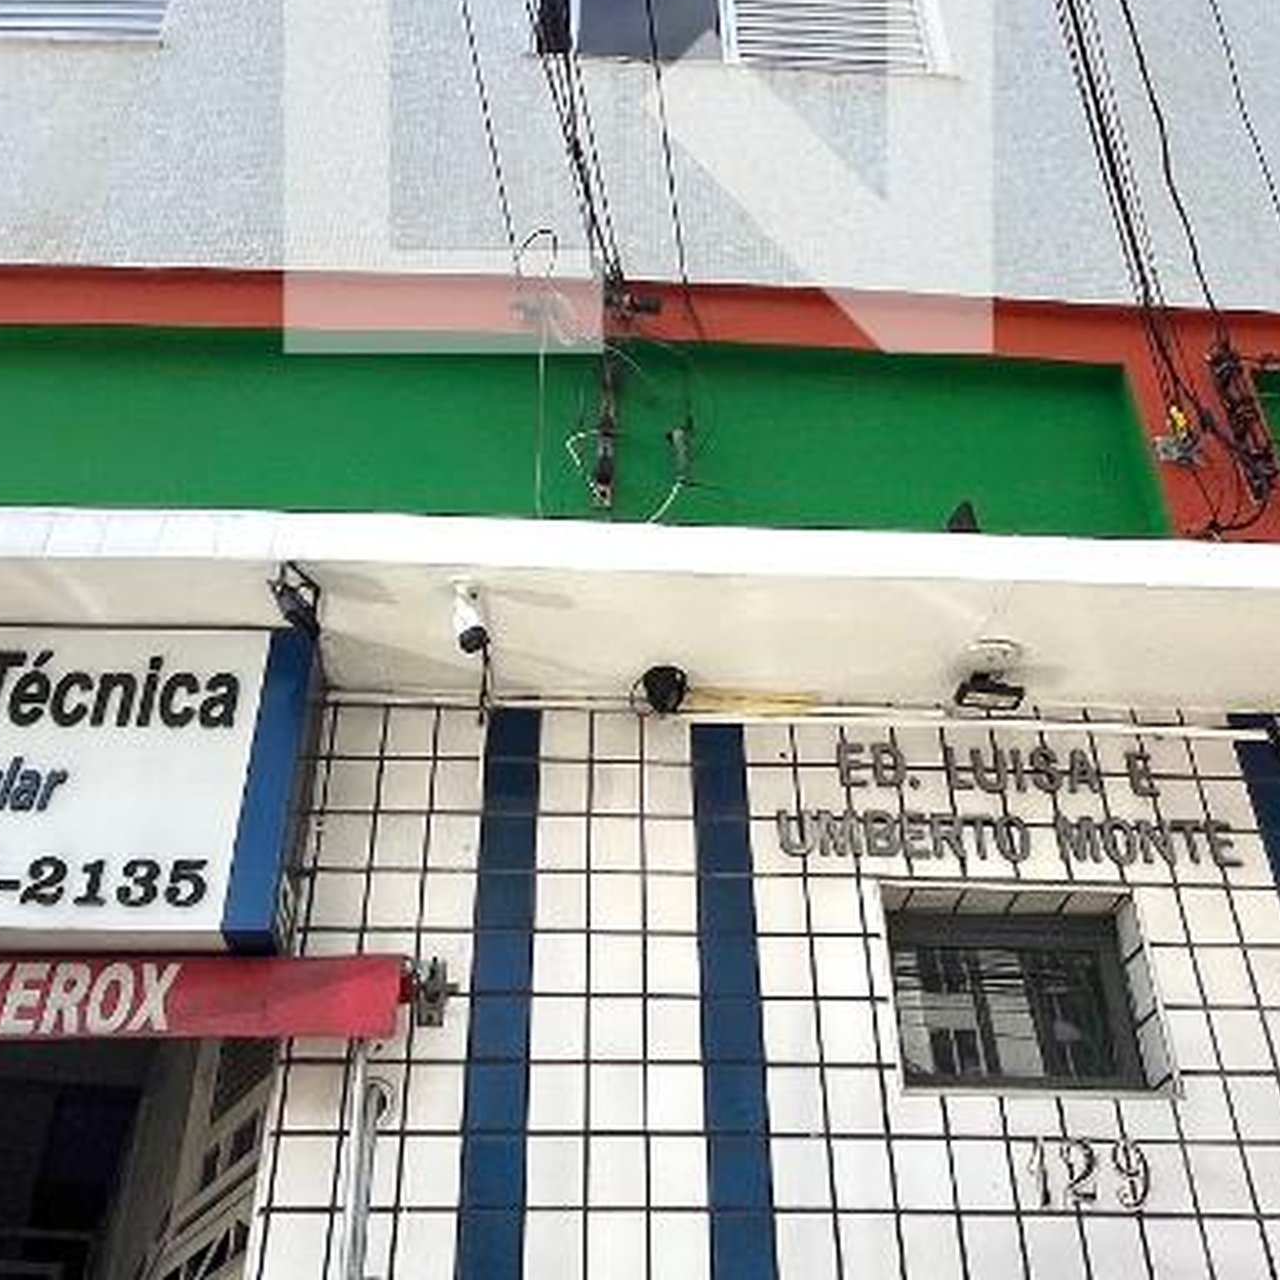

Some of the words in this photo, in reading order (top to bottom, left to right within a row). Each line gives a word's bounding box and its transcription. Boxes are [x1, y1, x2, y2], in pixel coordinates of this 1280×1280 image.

[836, 741, 921, 790] ED.
[944, 746, 1103, 795] LUISA
[1124, 750, 1161, 797] E
[776, 809, 1031, 862] UMBERTO
[1055, 816, 1245, 868] MONTE
[1028, 1136, 1151, 1210] 129
